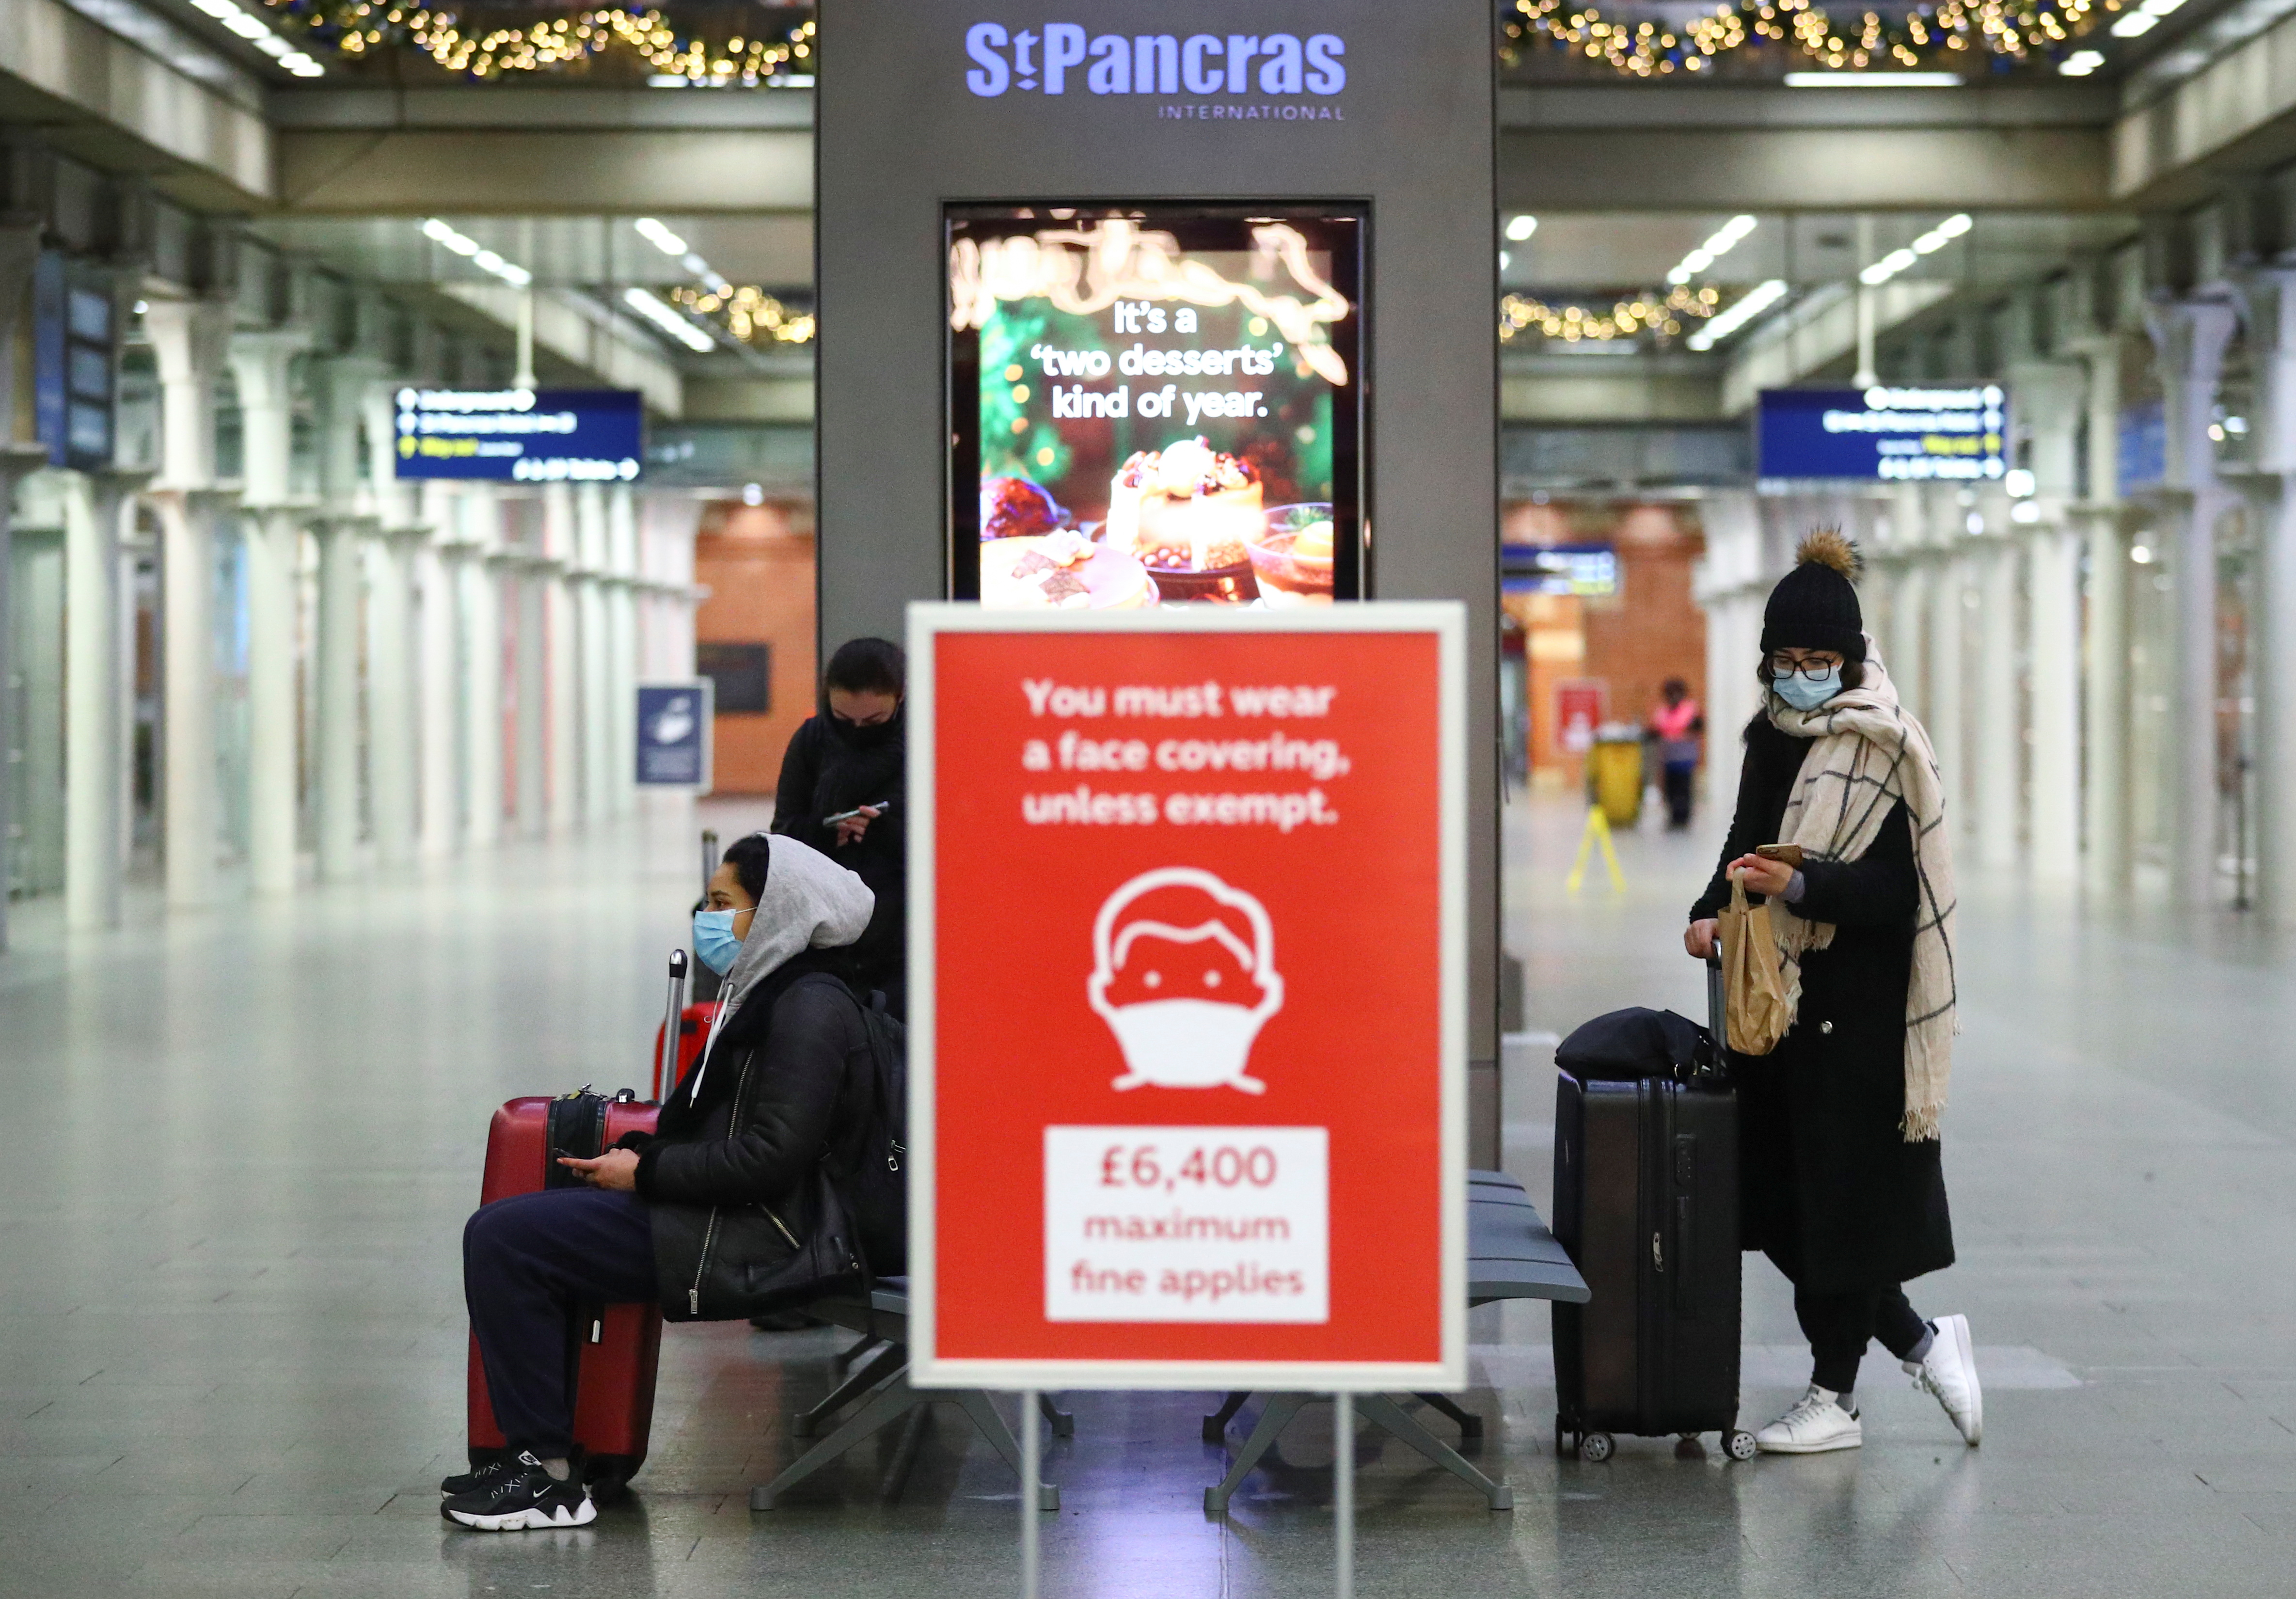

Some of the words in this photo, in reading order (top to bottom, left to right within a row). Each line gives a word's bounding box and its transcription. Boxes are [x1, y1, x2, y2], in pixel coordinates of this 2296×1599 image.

[1158, 104, 1345, 121] INTERNATIONAL
[1174, 307, 1197, 333] a
[1053, 384, 1128, 418] kind
[1137, 384, 1177, 418] of
[1182, 392, 1268, 426] year.
[1022, 679, 1107, 717] You
[1114, 681, 1223, 717] must
[1229, 685, 1336, 717] wear
[1022, 740, 1051, 771] a
[1059, 730, 1149, 771] face
[1156, 731, 1351, 780] covering,
[1022, 785, 1158, 824] unless
[1165, 788, 1338, 833] exempt.
[1100, 1145, 1278, 1192] £6,400
[1083, 1207, 1291, 1242] maximum
[1070, 1259, 1147, 1294] fine
[1159, 1261, 1306, 1303] applies
